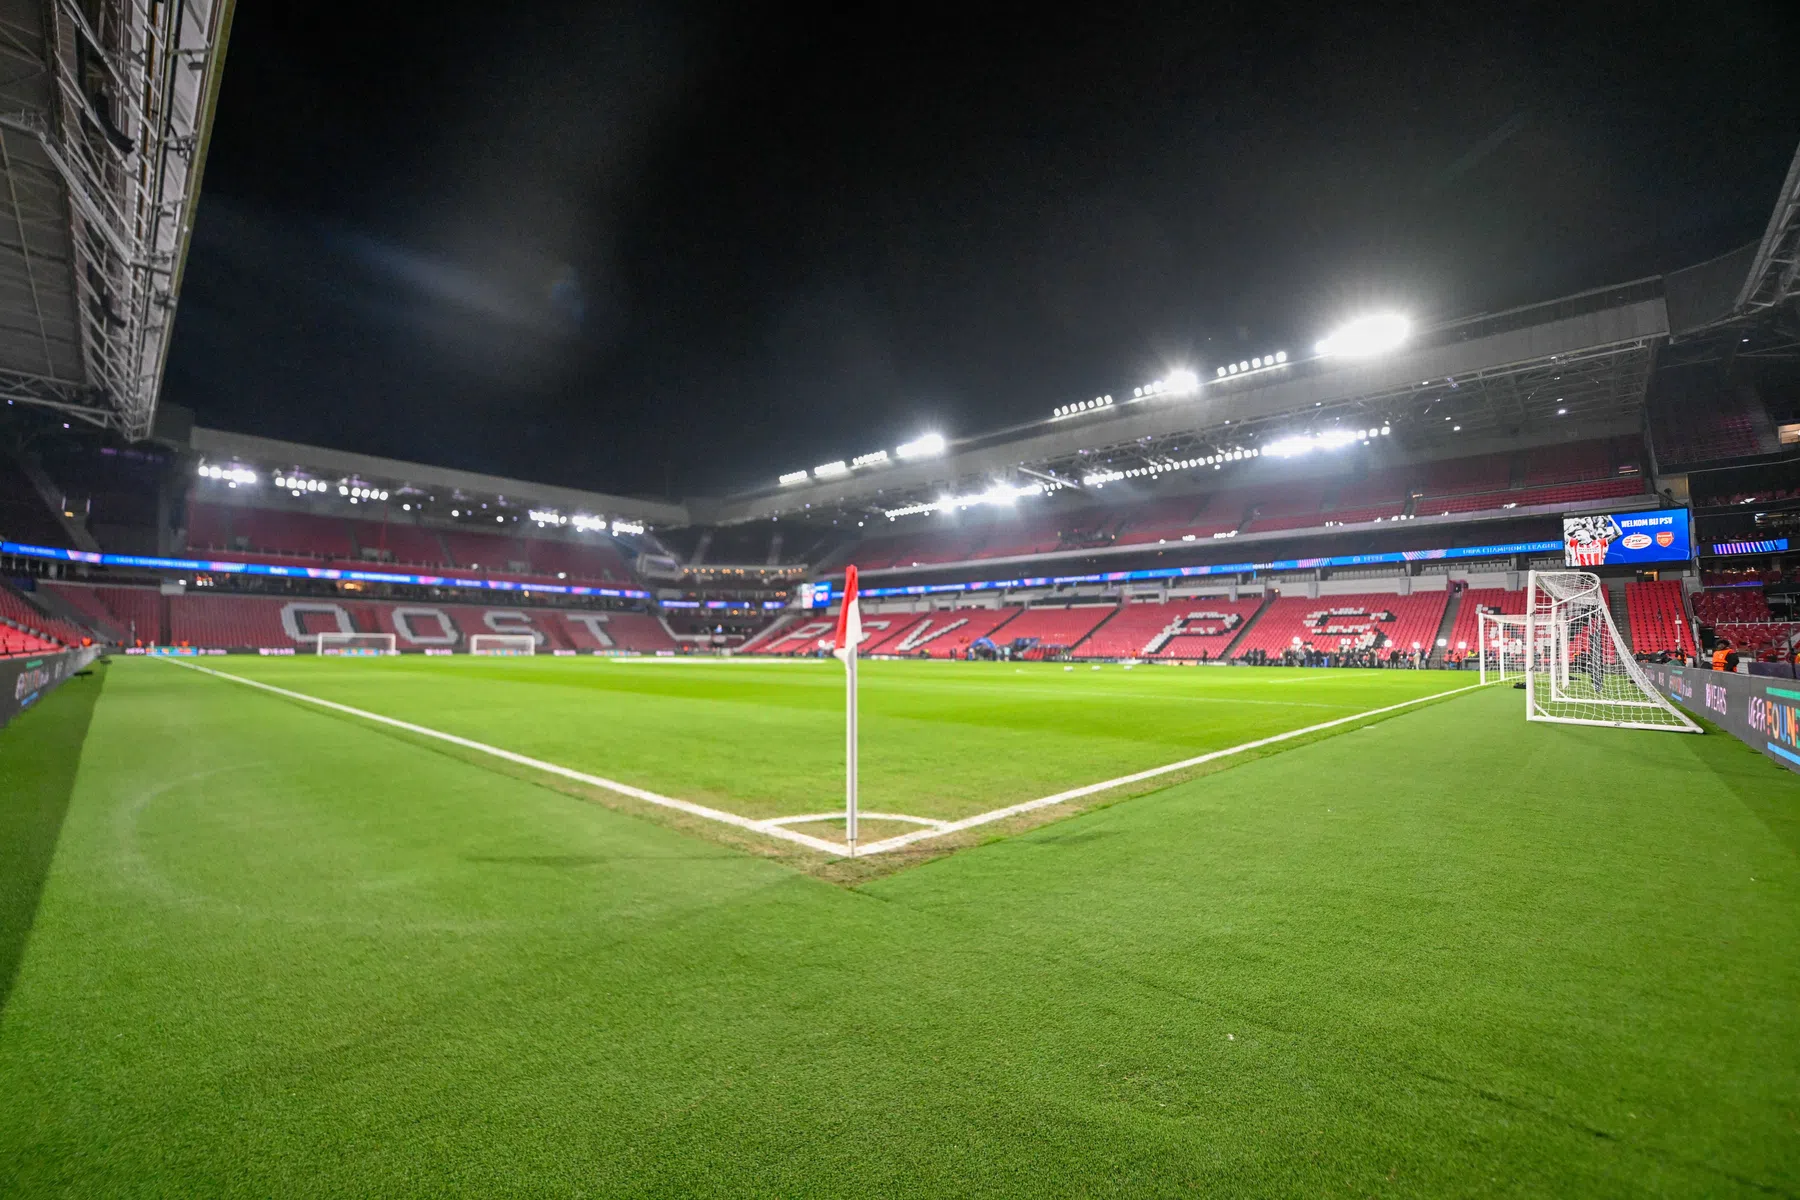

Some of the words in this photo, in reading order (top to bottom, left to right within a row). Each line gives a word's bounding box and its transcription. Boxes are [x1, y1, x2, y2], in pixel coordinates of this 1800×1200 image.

[1621, 519, 1648, 528] WELKOM
[1659, 516, 1673, 525] PSV
[1482, 545, 1526, 553] CHAMPIONS
[1527, 542, 1557, 550] LEAGUE
[280, 602, 615, 646] OOST
